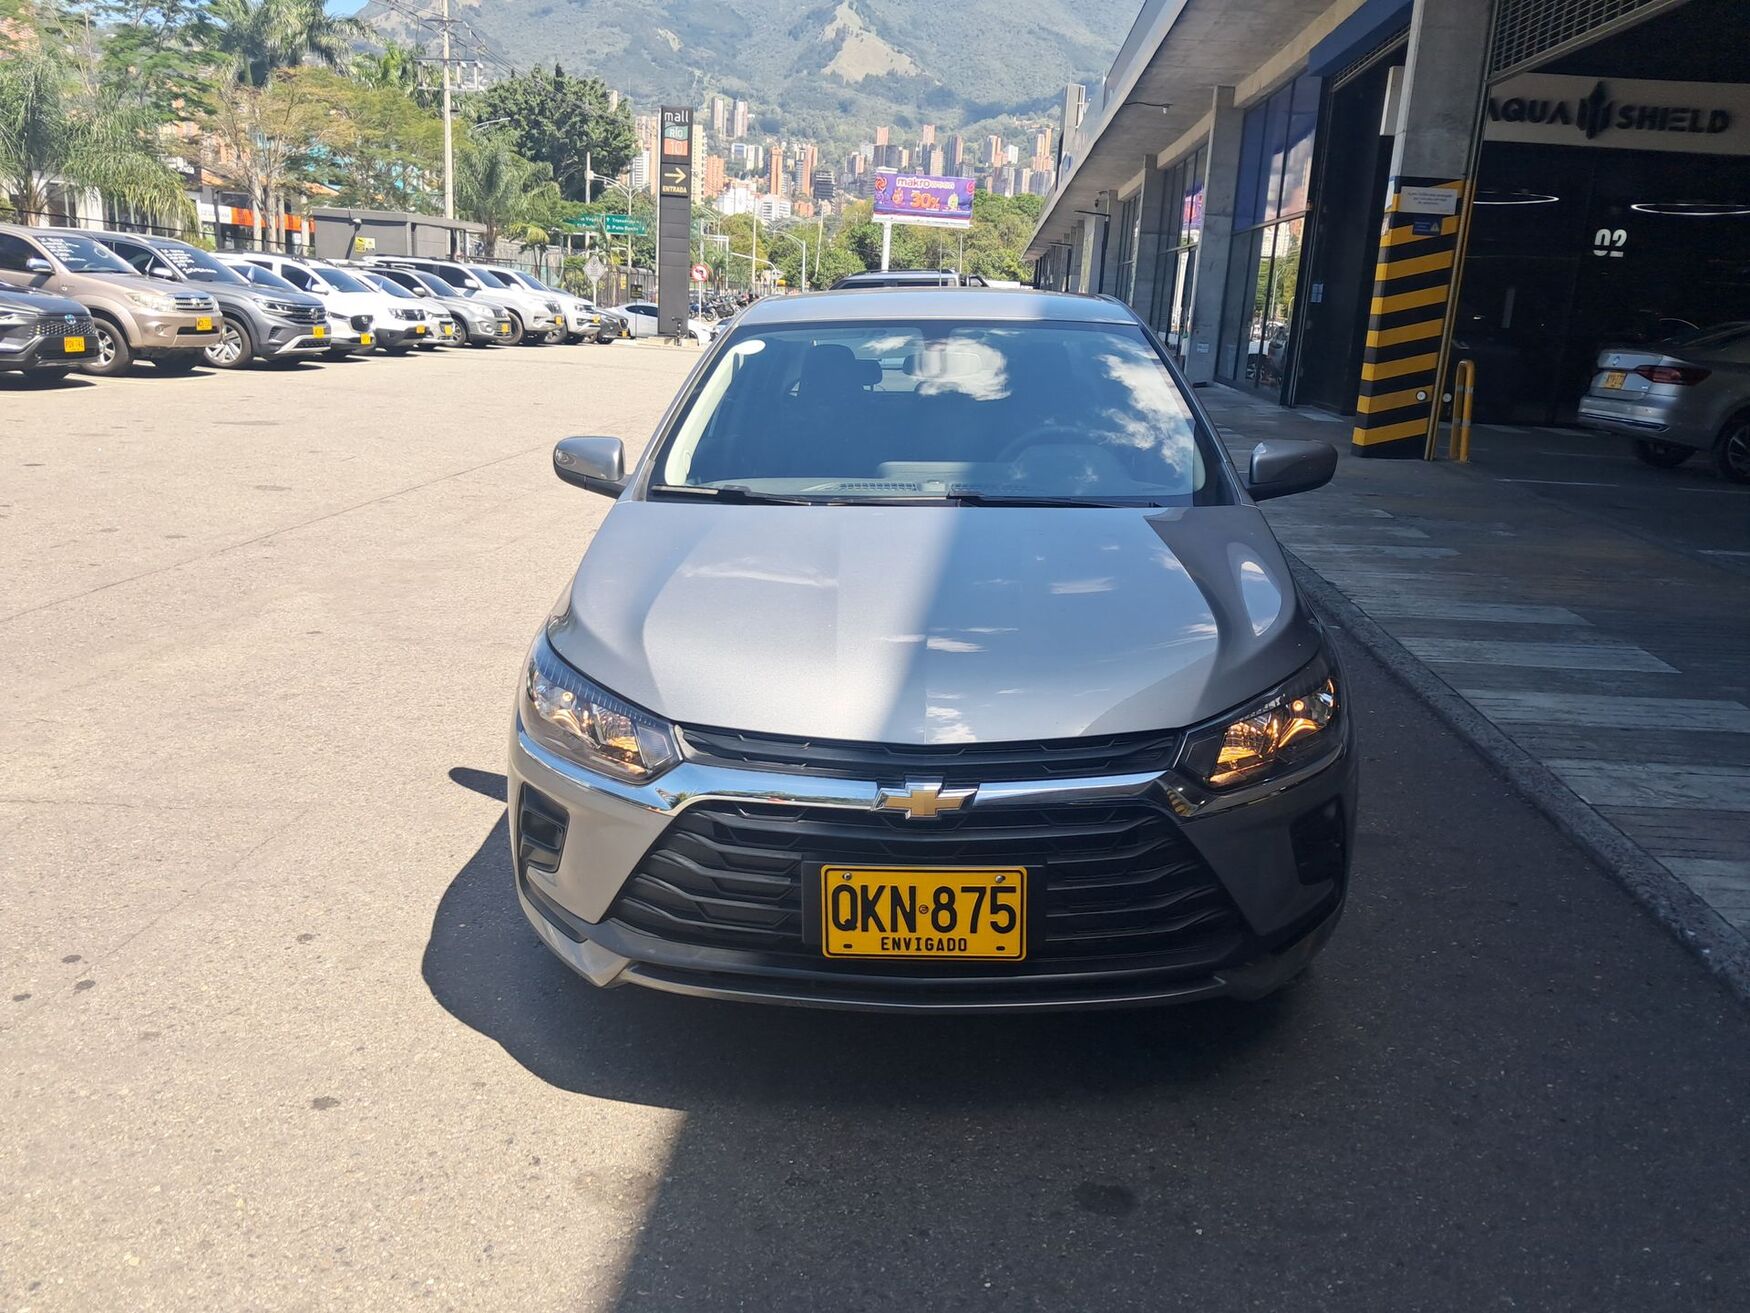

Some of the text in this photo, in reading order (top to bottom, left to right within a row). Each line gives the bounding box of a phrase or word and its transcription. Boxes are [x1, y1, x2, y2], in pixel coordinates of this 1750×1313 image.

[664, 110, 689, 122] mall
[1616, 104, 1730, 133] SHIELD
[662, 185, 688, 194] ENTRADA
[910, 192, 940, 209] 30%
[1592, 228, 1628, 258] 02
[880, 936, 968, 952] ENVIGADO
